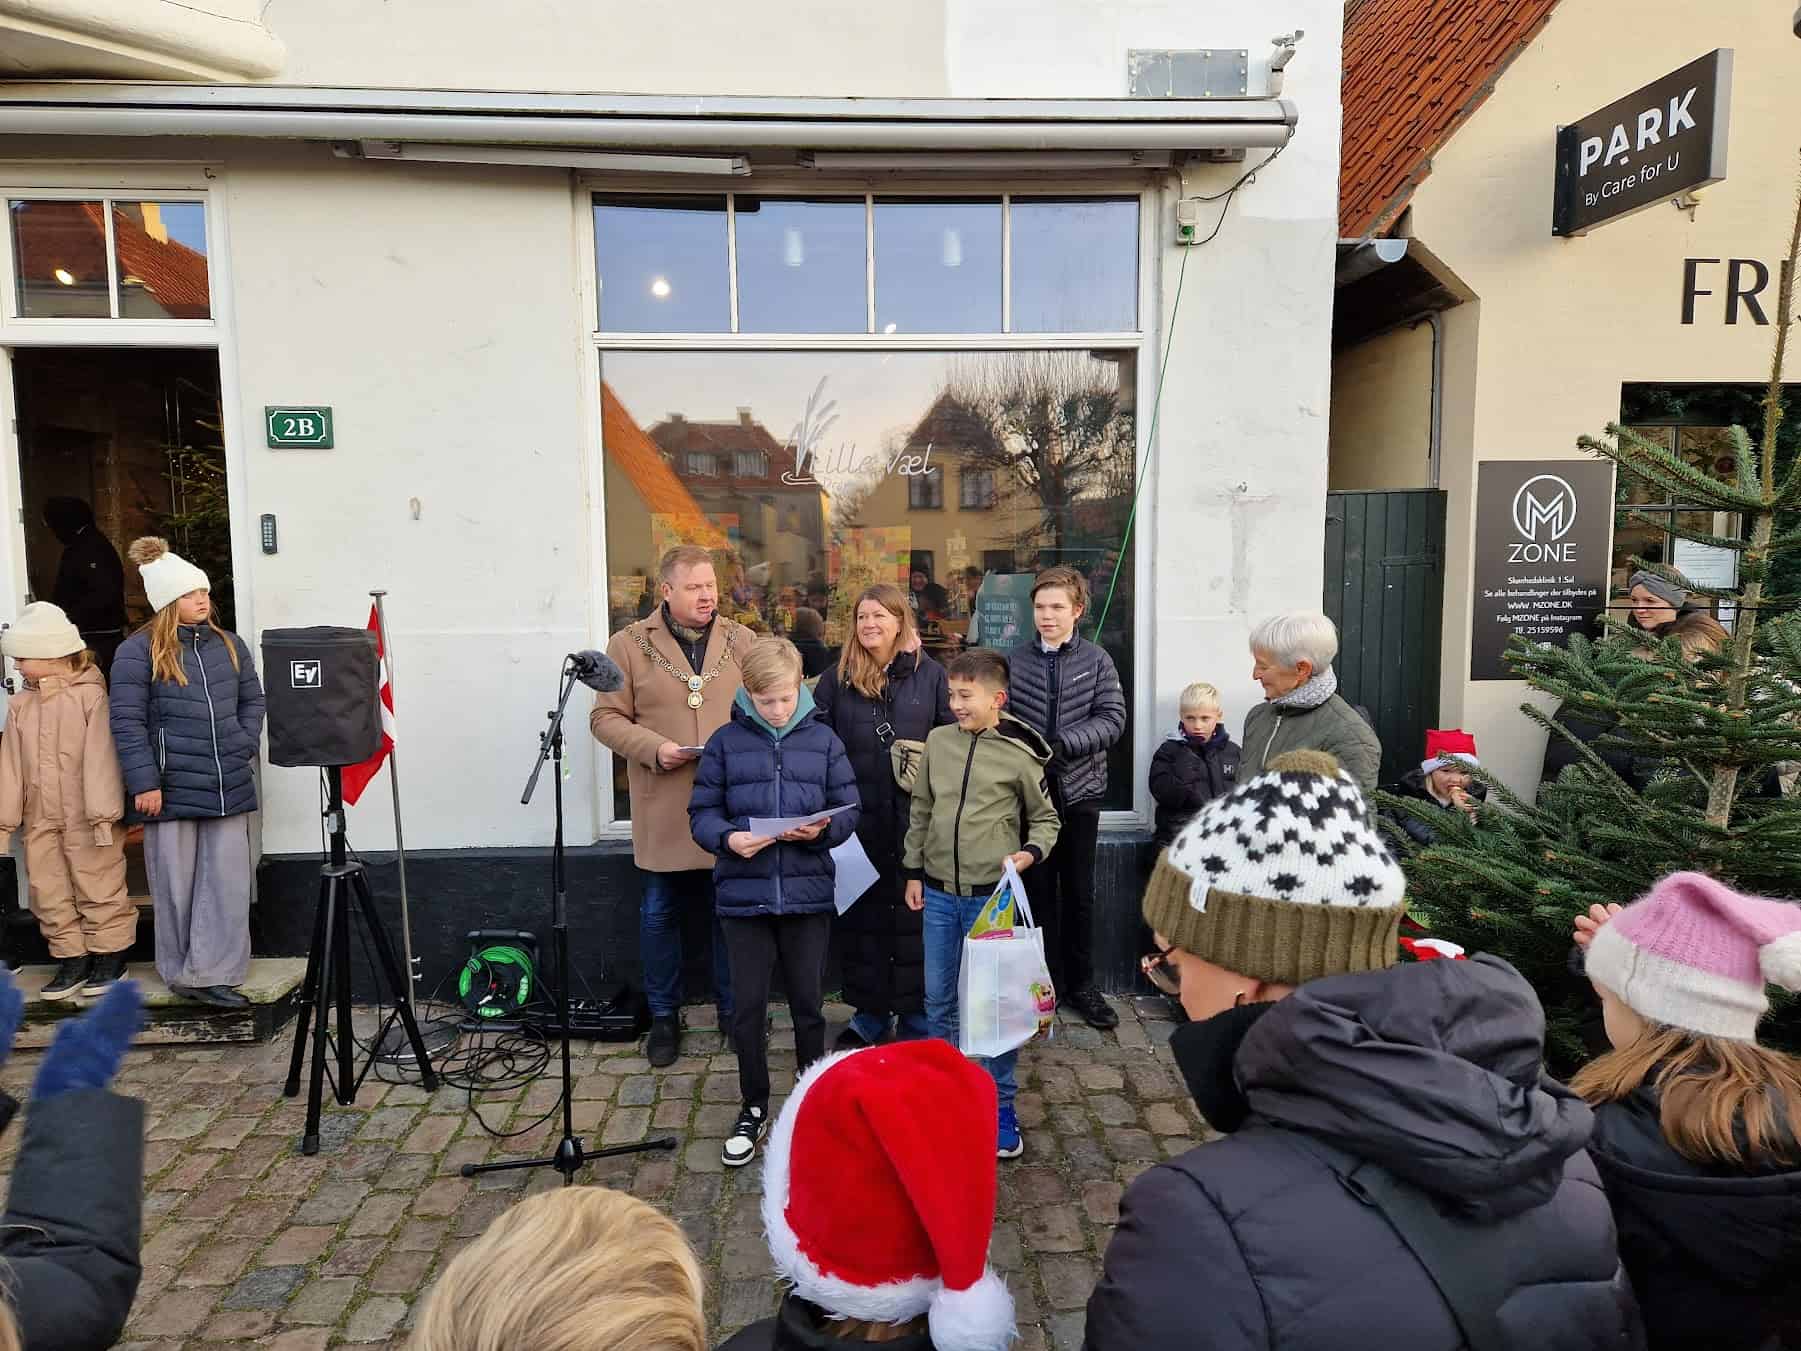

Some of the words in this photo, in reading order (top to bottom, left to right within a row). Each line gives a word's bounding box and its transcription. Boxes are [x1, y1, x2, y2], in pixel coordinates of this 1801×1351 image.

[1580, 88, 1697, 176] PARK
[1585, 192, 1600, 206] By
[1602, 175, 1636, 198] Care
[1640, 164, 1662, 183] for
[1667, 152, 1680, 171] U
[283, 417, 315, 437] 2B
[1508, 543, 1577, 563] ZONE
[1512, 614, 1540, 622] MZONE
[1550, 614, 1583, 623] Instagram
[295, 663, 319, 684] EV
